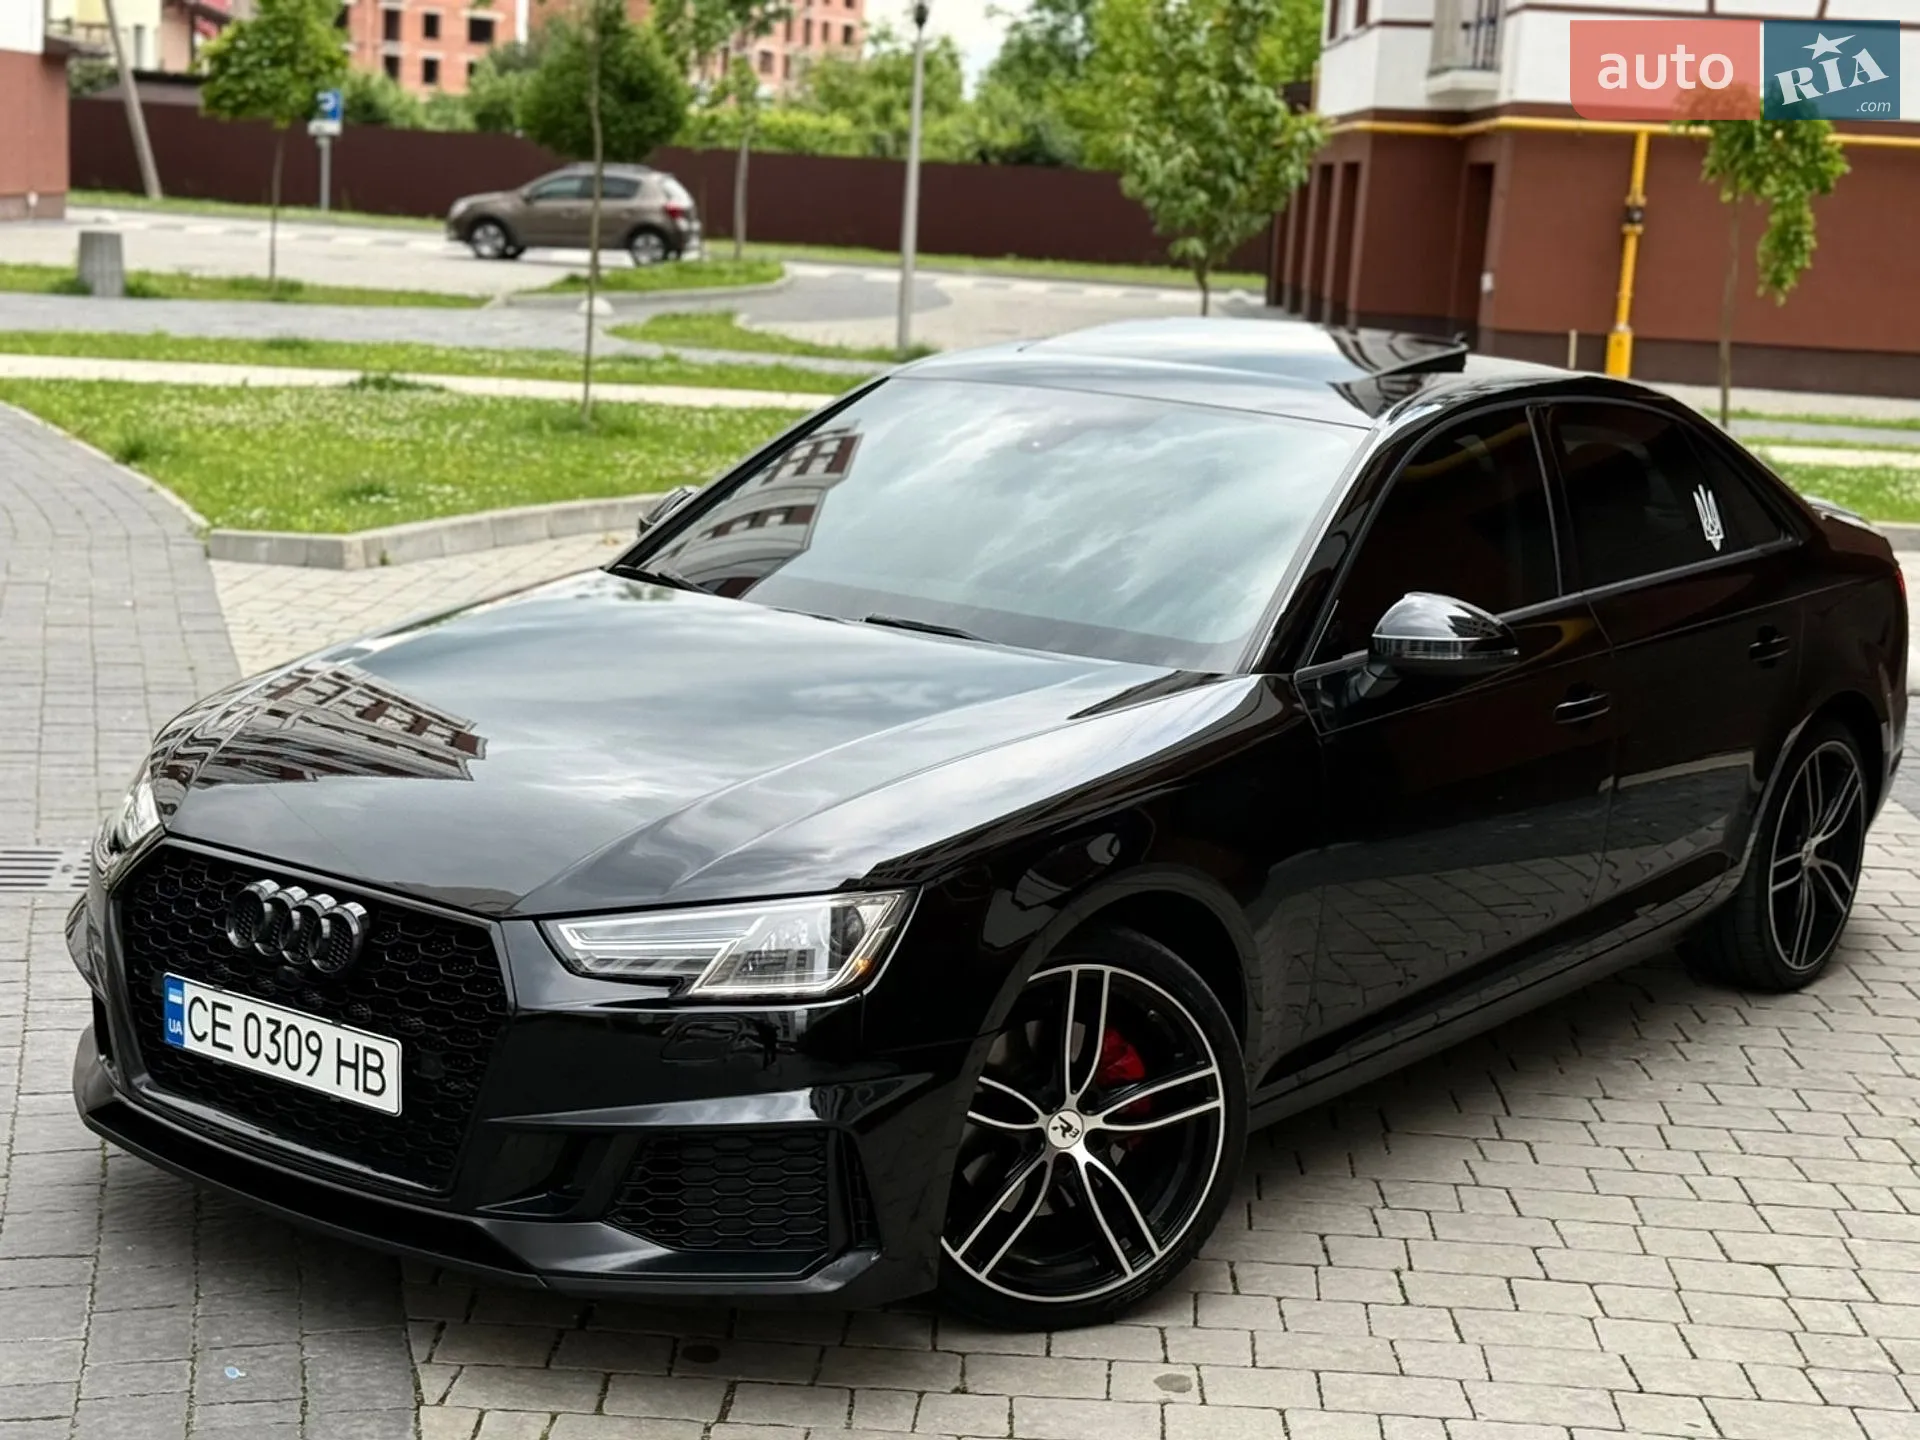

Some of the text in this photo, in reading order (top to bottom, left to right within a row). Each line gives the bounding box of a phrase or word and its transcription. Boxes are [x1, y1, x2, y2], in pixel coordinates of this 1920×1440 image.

[168, 1018, 182, 1035] UA
[188, 996, 386, 1097] CE 0309 HB
